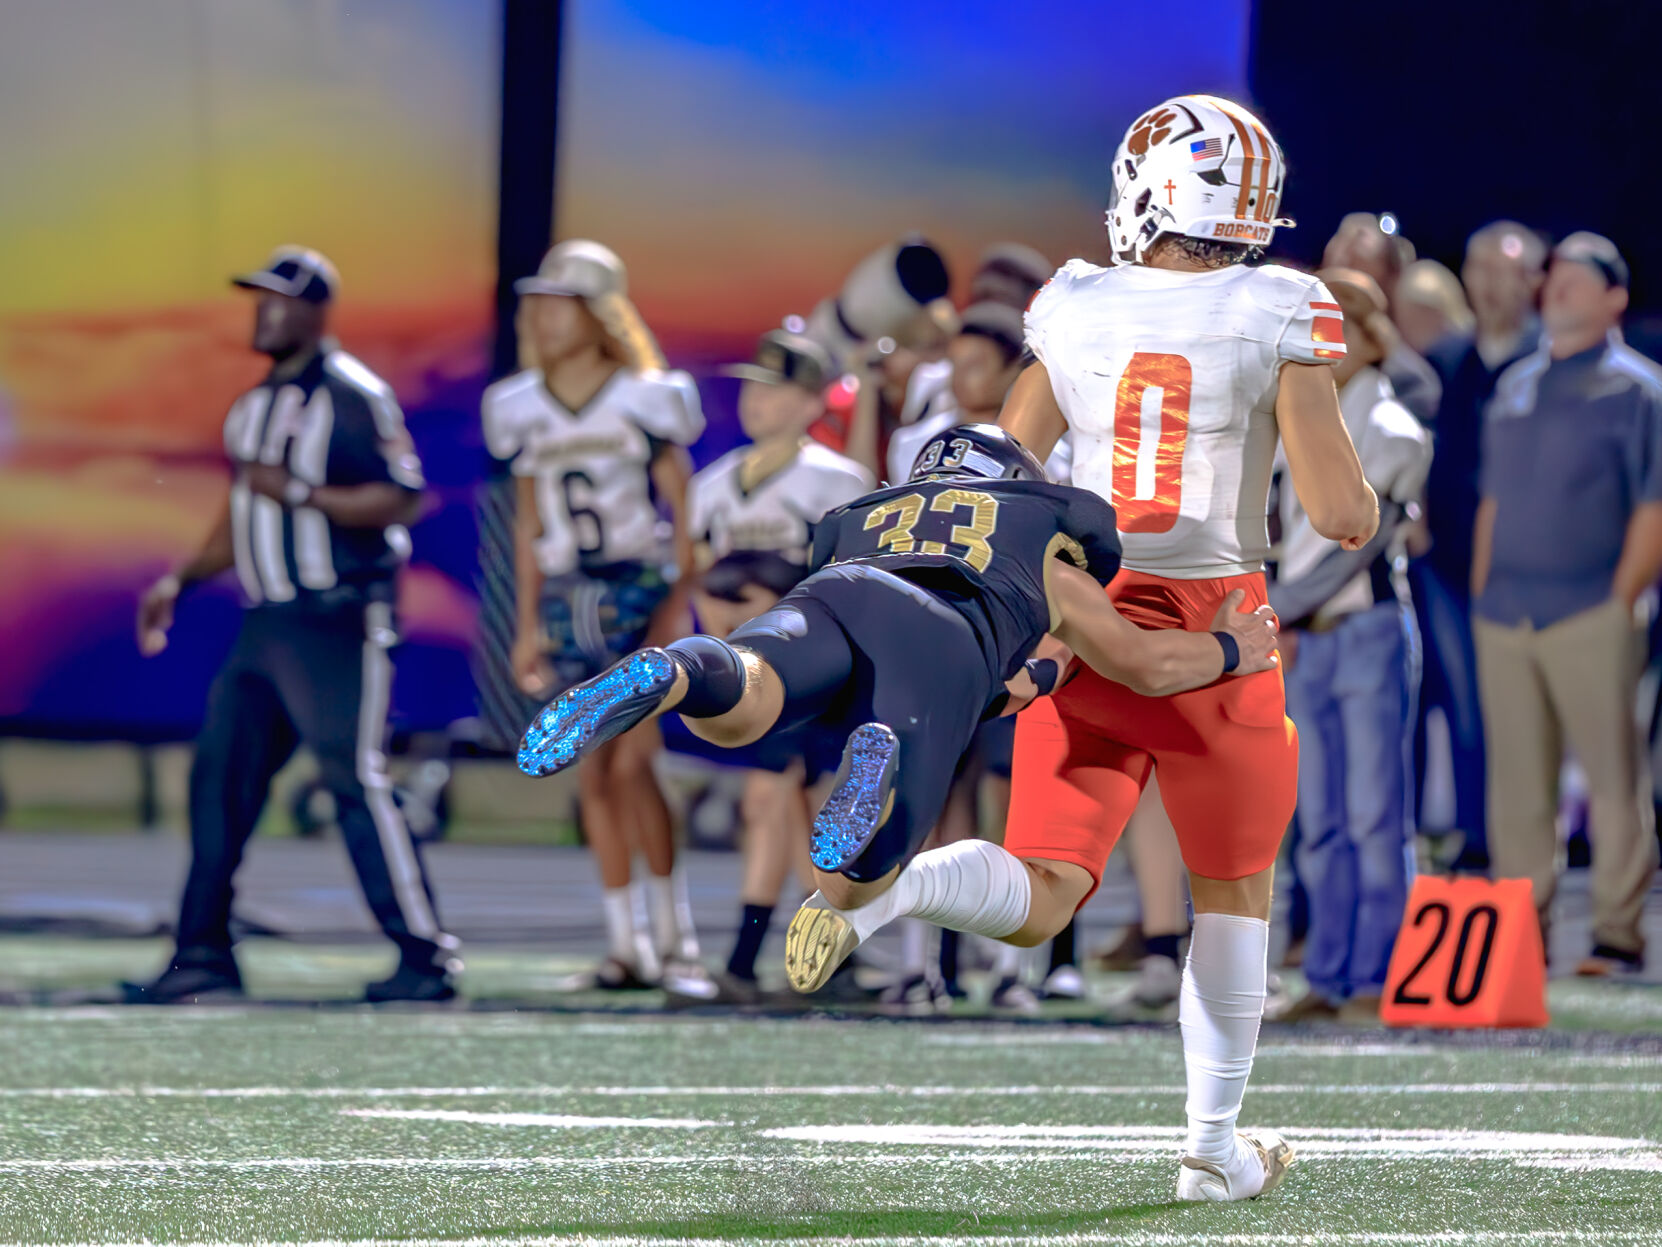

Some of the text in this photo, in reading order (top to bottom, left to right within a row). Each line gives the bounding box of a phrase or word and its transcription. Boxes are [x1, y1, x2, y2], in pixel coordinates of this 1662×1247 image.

[1213, 222, 1270, 242] BOBCATS
[920, 438, 974, 472] 33
[1111, 352, 1192, 533] 0
[561, 470, 604, 556] 6
[863, 489, 999, 573] 33
[1393, 902, 1499, 1007] 20
